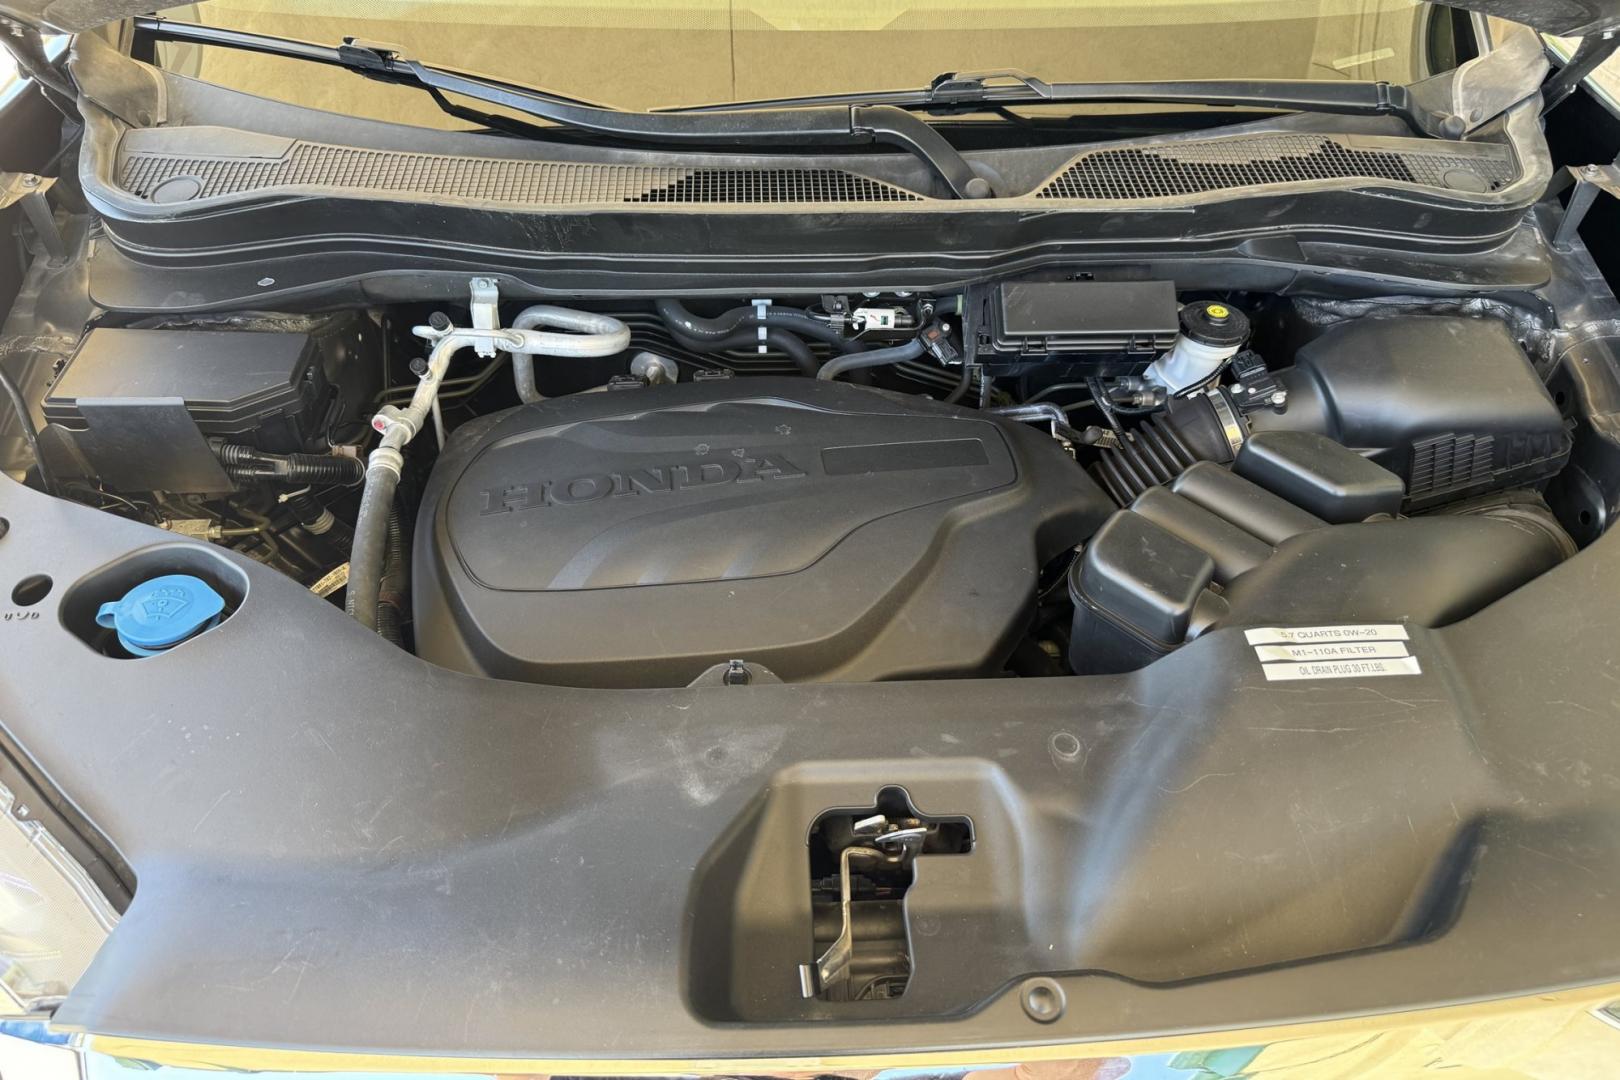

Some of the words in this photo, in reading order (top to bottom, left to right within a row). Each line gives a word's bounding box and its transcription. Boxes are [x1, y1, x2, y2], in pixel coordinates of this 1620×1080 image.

[480, 455, 807, 516] HONDA
[1297, 629, 1342, 639] QUARTS
[1343, 628, 1377, 637] 0W-20
[1291, 647, 1338, 657] M1-110A
[1340, 646, 1377, 655] FILTER
[1299, 666, 1311, 676] OIL
[1312, 665, 1333, 675] DRAIN
[1333, 664, 1351, 674] PLUG
